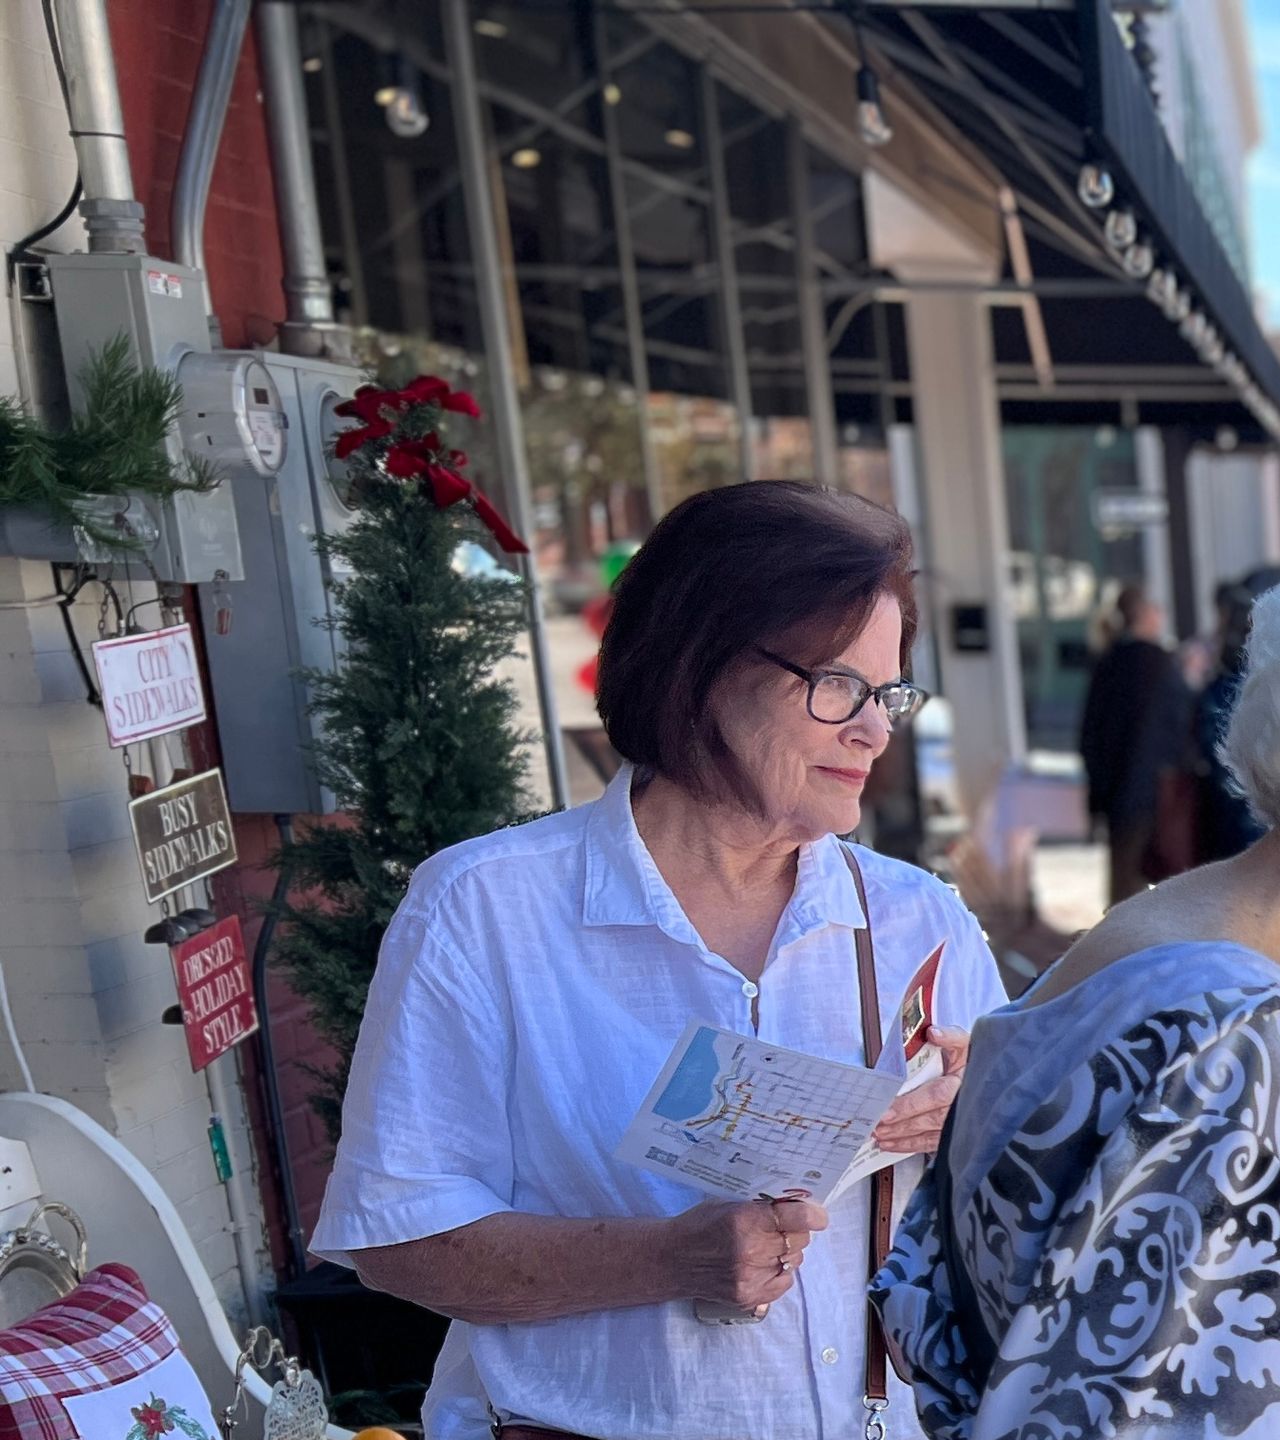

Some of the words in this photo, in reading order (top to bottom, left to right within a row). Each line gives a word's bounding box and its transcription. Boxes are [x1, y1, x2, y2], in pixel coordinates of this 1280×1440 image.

[136, 645, 173, 684] CITY
[113, 676, 200, 729] SIDEWALKS
[157, 791, 199, 837] BUSY
[144, 820, 229, 884] SIDEWALKS
[182, 935, 234, 988] DRESSED
[190, 962, 248, 1024] HOLIDAY
[202, 1003, 245, 1054] STYLE
